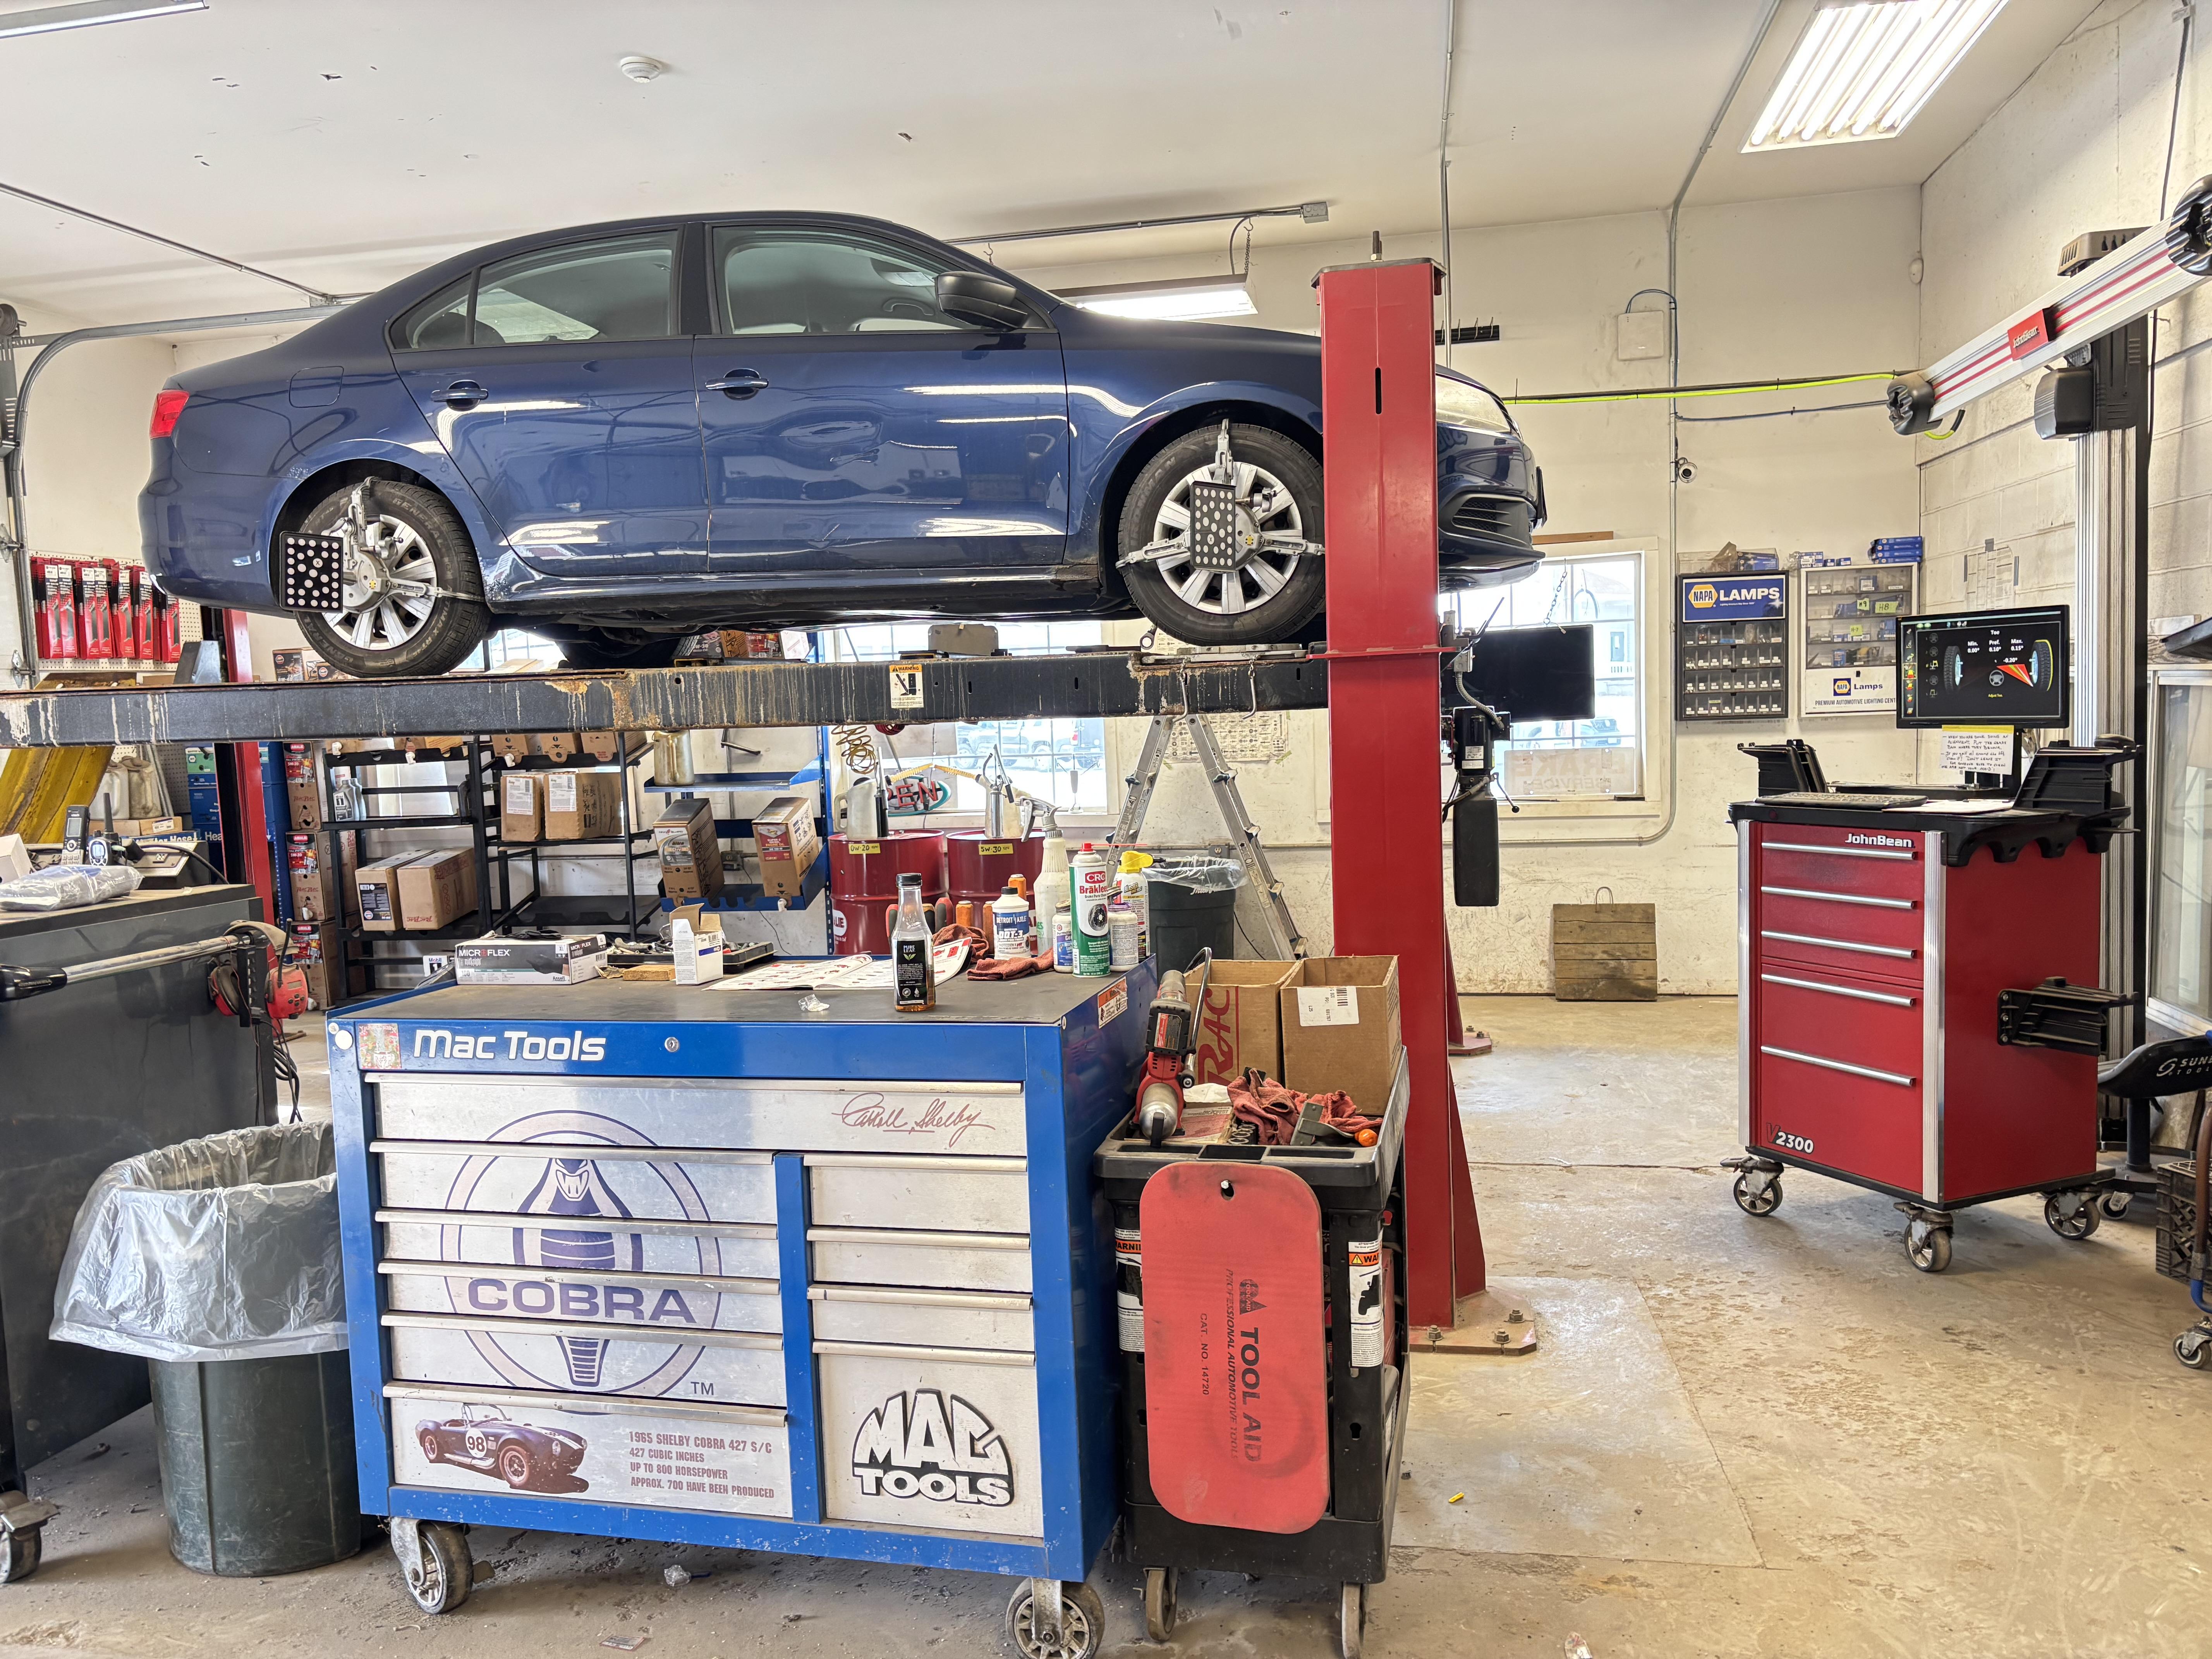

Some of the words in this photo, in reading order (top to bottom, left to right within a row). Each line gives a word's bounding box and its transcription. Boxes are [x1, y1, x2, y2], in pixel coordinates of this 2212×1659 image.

[1693, 591, 1713, 602] NAPA
[1719, 587, 1780, 601] LAMPS
[1844, 833, 1912, 848] JohnBean
[459, 949, 511, 957] MICROFLEX
[503, 1030, 606, 1062] Tools
[467, 1278, 697, 1324] COBRA
[1226, 1269, 1235, 1350] PROFESSIONAL
[1240, 1327, 1260, 1406] TOOL
[690, 1381, 716, 1396] TM
[1227, 1352, 1237, 1426] AUTOMOTIVE
[467, 1436, 485, 1452] 98
[629, 1431, 653, 1444] 1965
[656, 1433, 690, 1447] SHELBY
[694, 1436, 725, 1450] COBRA
[728, 1439, 747, 1451] 427
[750, 1441, 772, 1454] S/C
[852, 1389, 1008, 1475] MAC
[1230, 1426, 1238, 1460] TOOLS
[1243, 1412, 1262, 1462] AID
[629, 1448, 645, 1458] 427
[648, 1449, 673, 1460] CUBIC
[676, 1451, 705, 1463] INCHES
[630, 1462, 641, 1472] UP
[644, 1463, 653, 1473] TO
[675, 1465, 728, 1480] HORSEPOWER
[631, 1476, 665, 1489] APPROX.
[667, 1480, 683, 1491] 700
[686, 1481, 706, 1492] HAVE
[709, 1483, 728, 1495] BEEN
[731, 1485, 775, 1498] PRODUCED
[853, 1466, 1014, 1507] TOOLS
